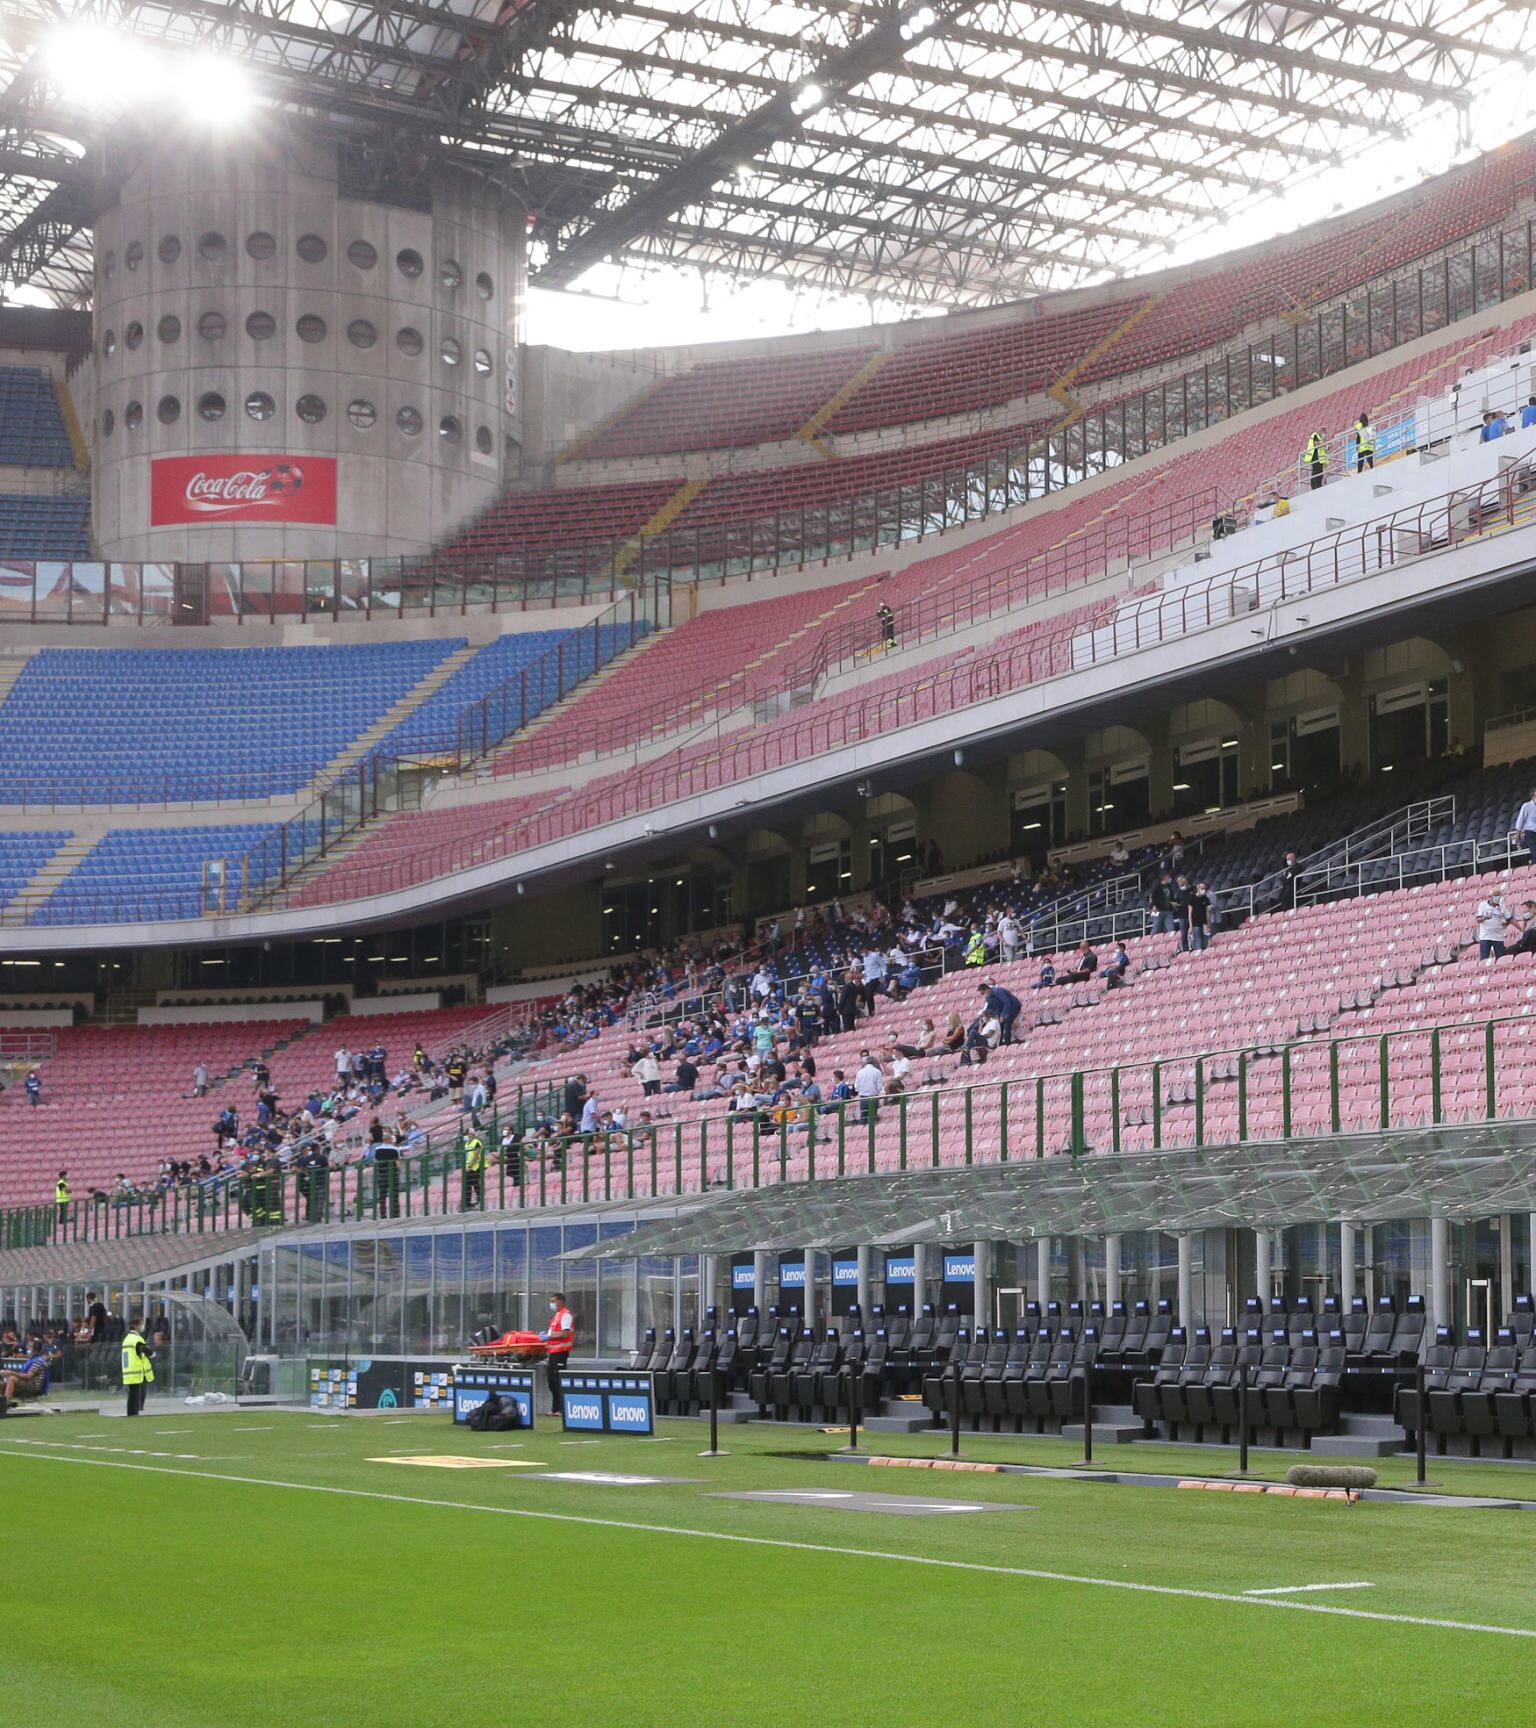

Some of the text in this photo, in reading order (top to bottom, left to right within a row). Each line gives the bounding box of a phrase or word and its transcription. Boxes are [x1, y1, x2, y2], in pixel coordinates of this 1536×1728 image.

[186, 472, 271, 500] Coca-Cola
[734, 1270, 754, 1283] Lenov
[835, 1266, 858, 1280] Lenov
[567, 1401, 599, 1420] Lenovo
[612, 1403, 645, 1422] Lenovo
